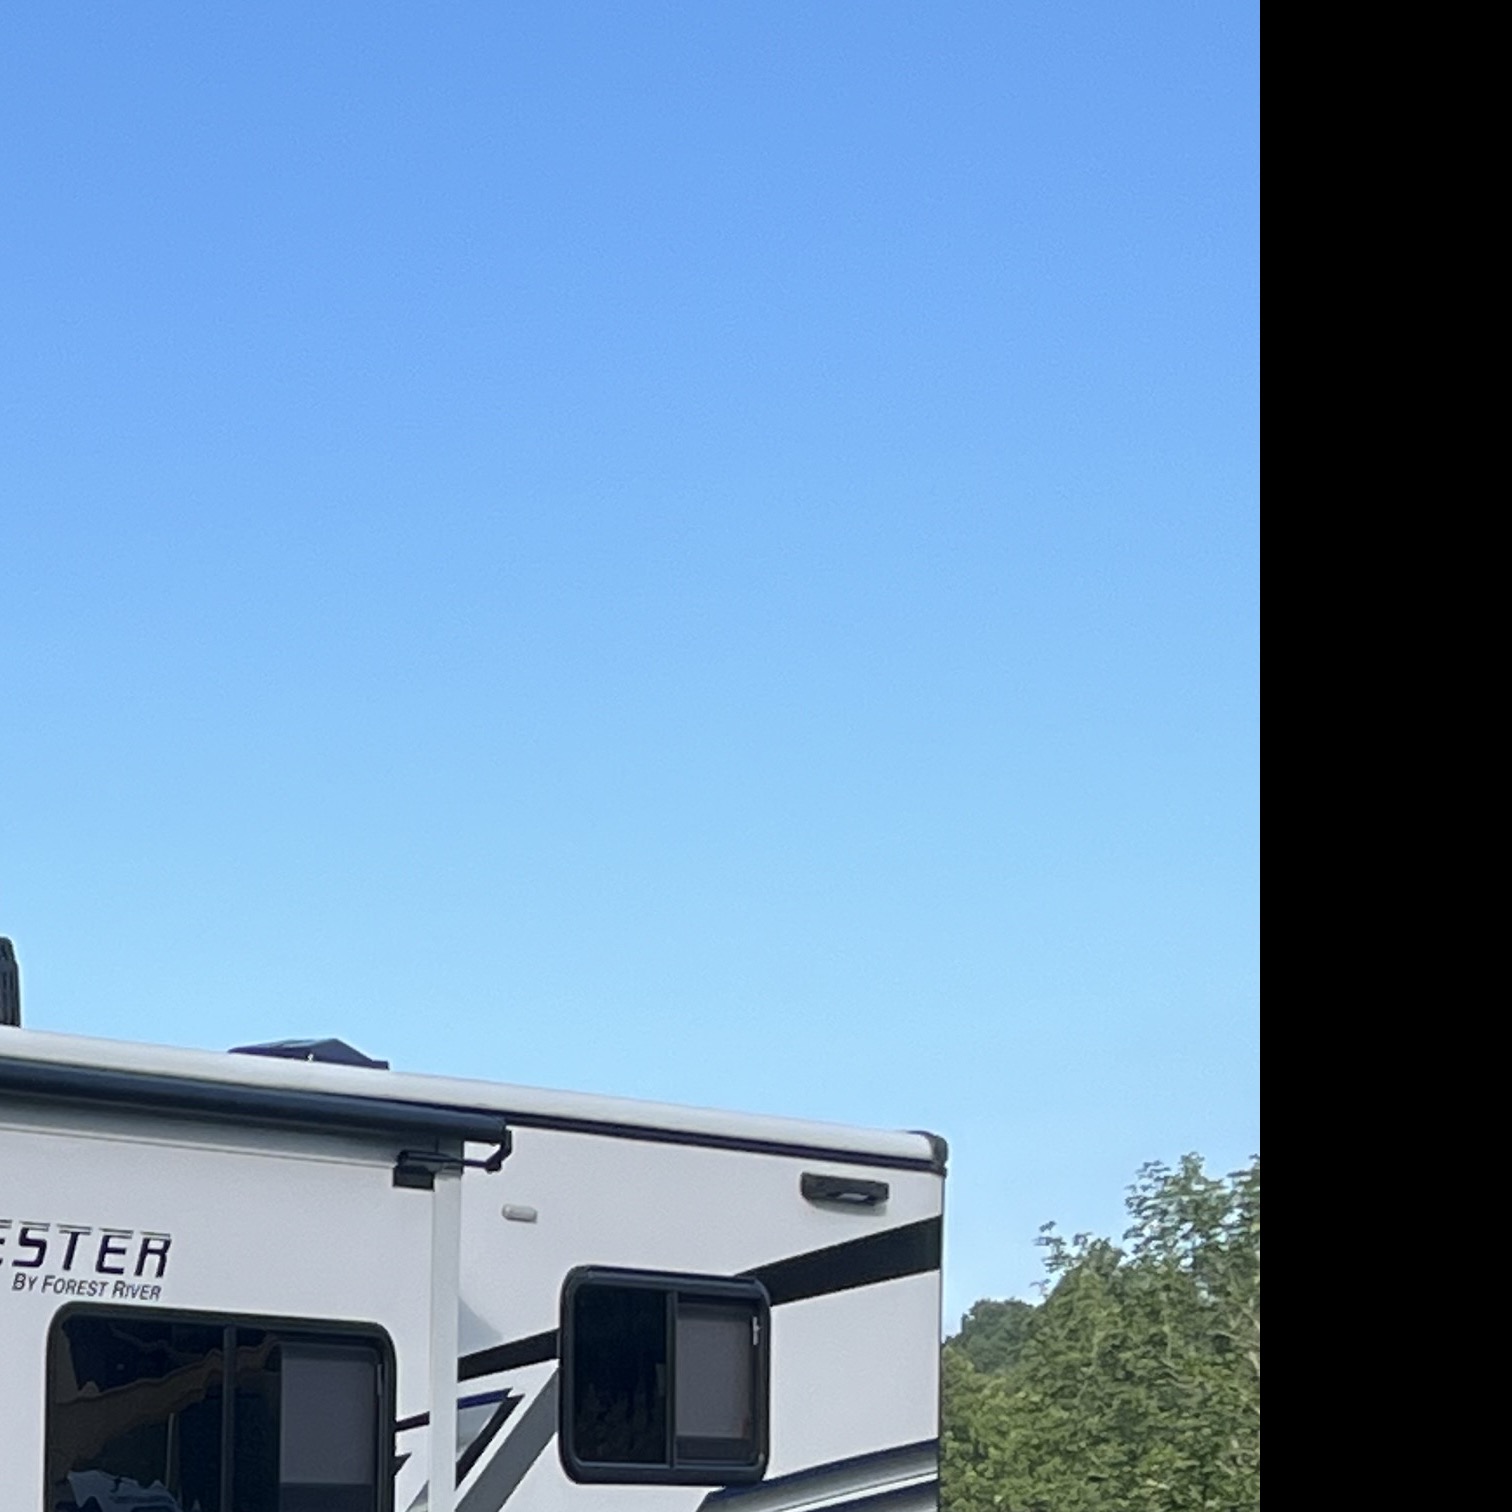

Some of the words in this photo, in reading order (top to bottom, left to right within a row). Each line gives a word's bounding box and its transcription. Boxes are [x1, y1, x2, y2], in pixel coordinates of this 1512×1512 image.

[11, 1271, 39, 1292] BY
[41, 1274, 110, 1297] FOREST
[111, 1279, 163, 1301] RIVER
